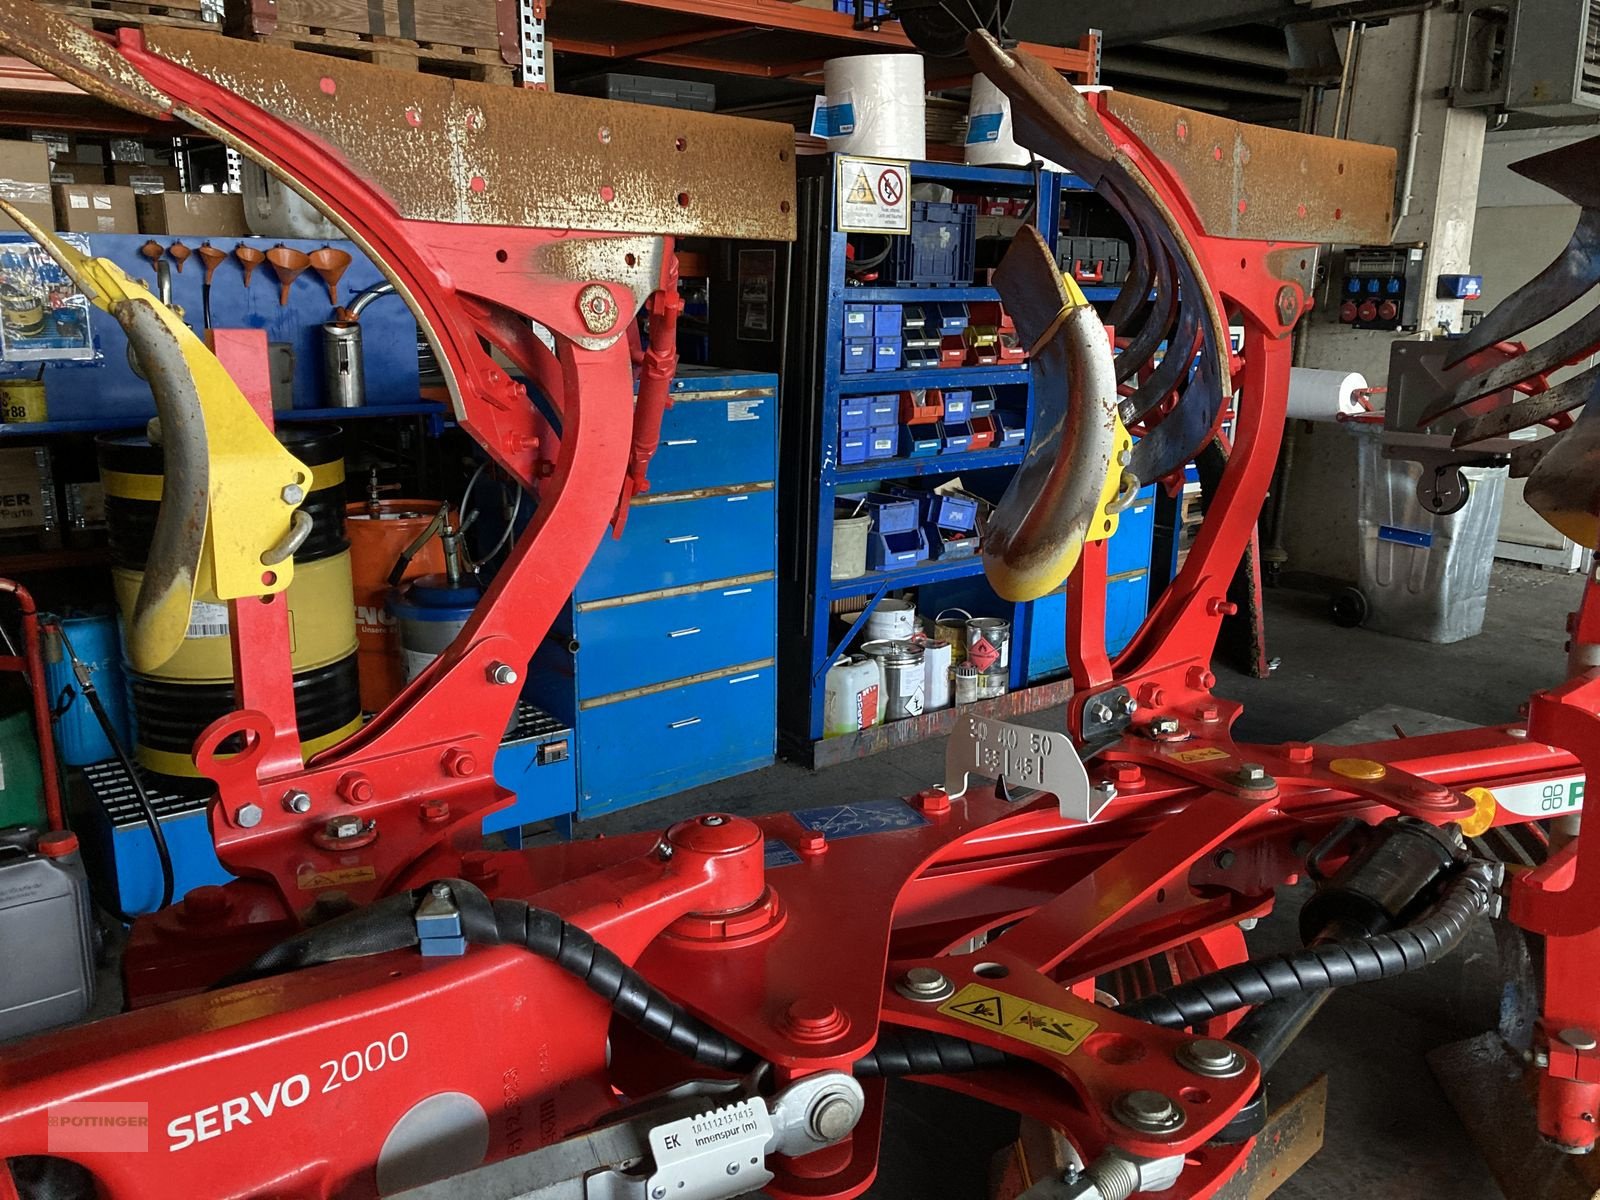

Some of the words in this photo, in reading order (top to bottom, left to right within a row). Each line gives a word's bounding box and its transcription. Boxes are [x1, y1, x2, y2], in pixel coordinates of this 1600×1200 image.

[0, 494, 31, 507] ER
[997, 728, 1018, 749] 40
[1030, 733, 1052, 756] 50
[1015, 756, 1033, 775] 45
[167, 1073, 310, 1152] SERVO
[319, 1031, 409, 1094] 2000
[664, 1133, 681, 1150] EK
[695, 1126, 740, 1147] Innenspur
[741, 1119, 758, 1133] (m)
